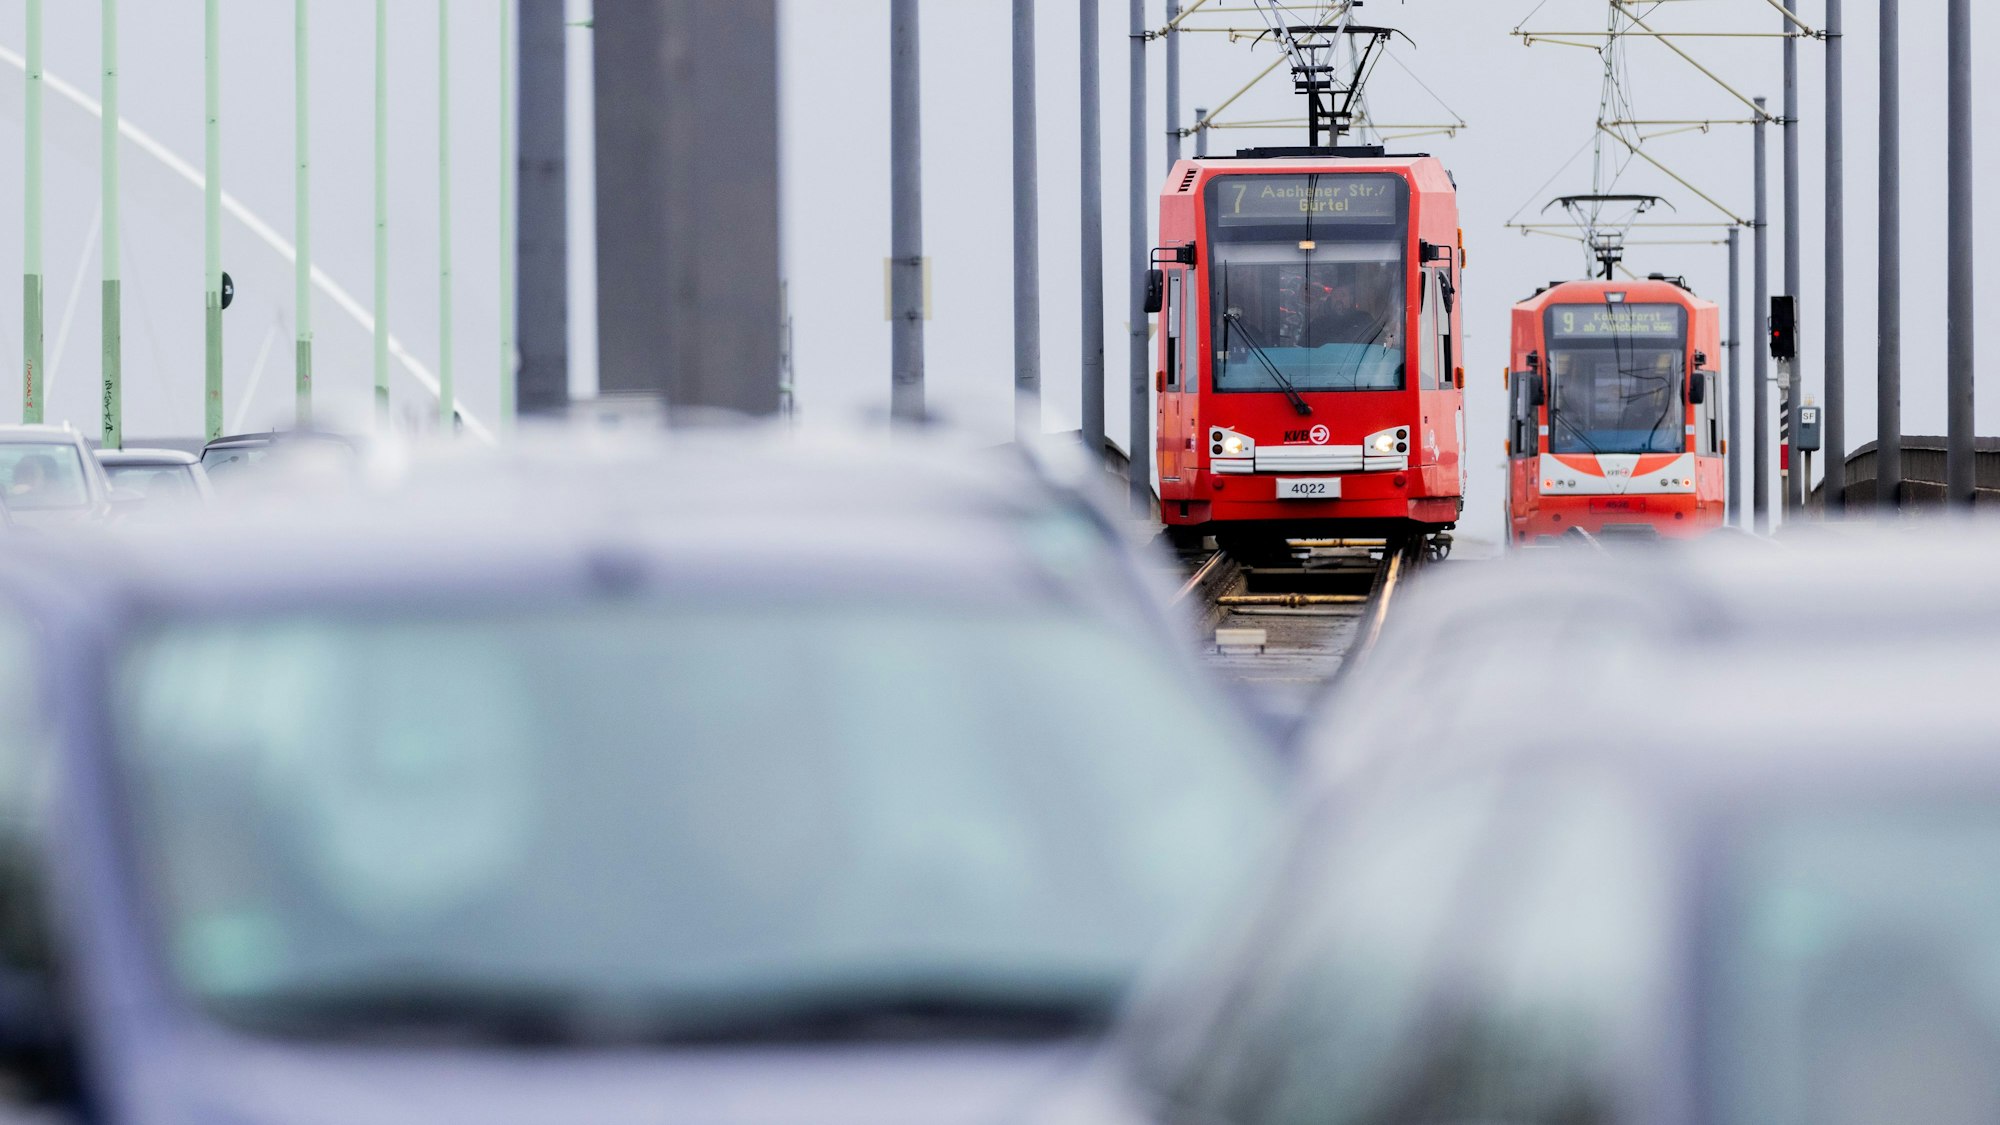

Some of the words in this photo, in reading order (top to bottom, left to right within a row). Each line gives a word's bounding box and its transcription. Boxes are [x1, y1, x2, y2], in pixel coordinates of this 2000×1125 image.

[1232, 184, 1247, 214] 7
[1261, 185, 1341, 198] Aachener
[1563, 312, 1574, 333] 9
[1584, 322, 1596, 332] ab
[1284, 430, 1310, 441] KVB
[1292, 484, 1326, 494] 4022
